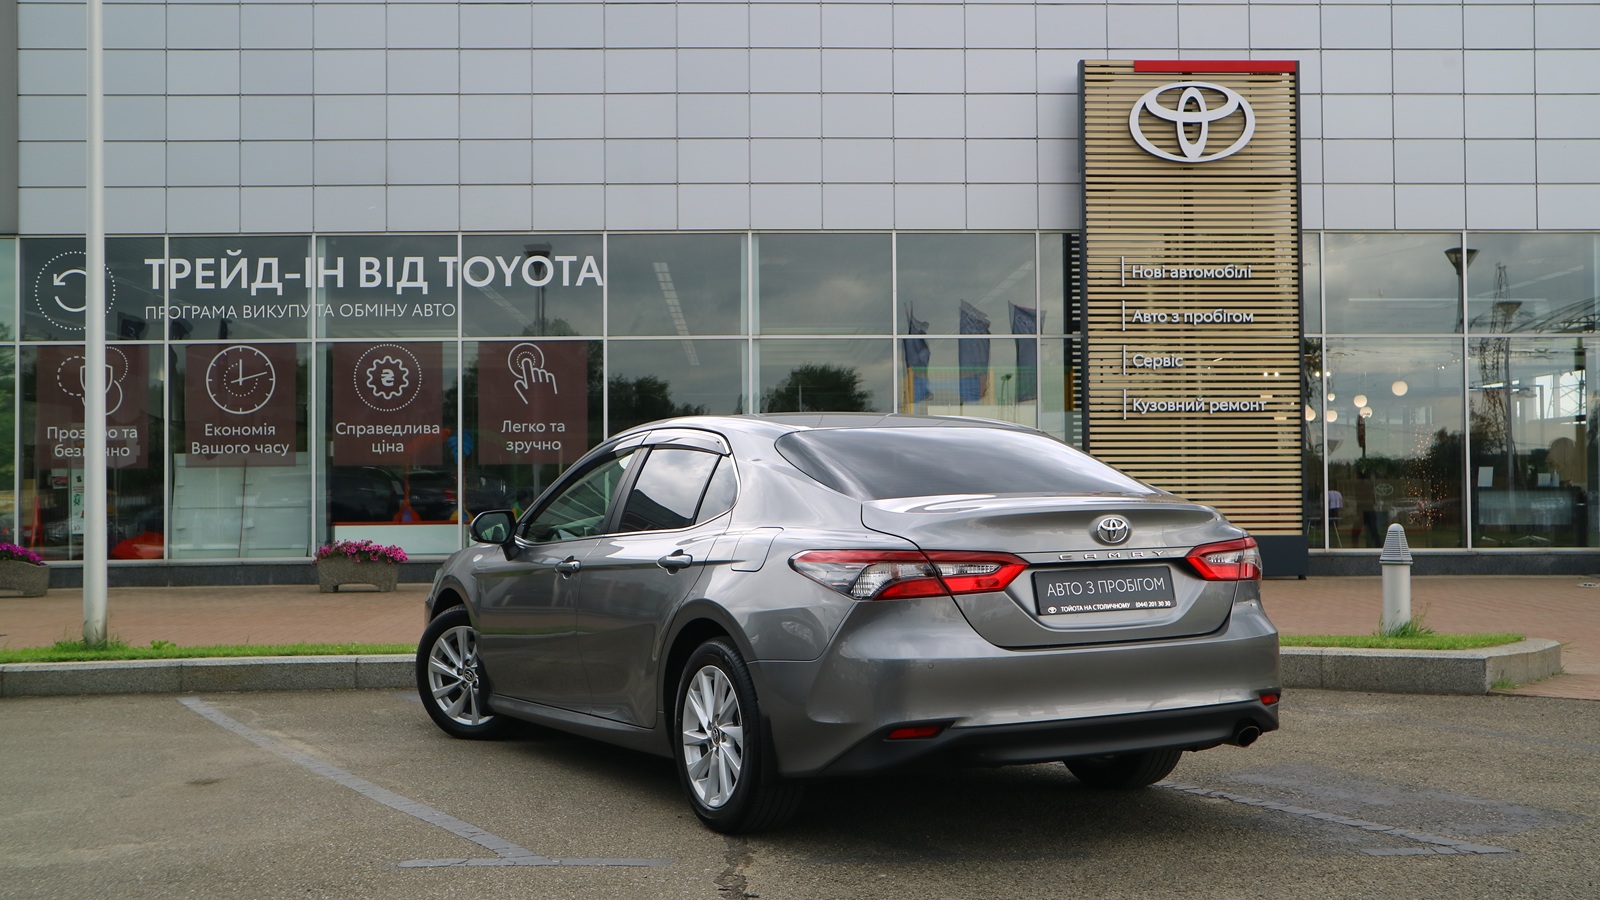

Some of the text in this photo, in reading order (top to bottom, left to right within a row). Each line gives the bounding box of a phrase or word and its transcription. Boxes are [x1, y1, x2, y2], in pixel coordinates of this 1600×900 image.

[144, 249, 604, 296] ТРЕЙД-ІН ВІД TOYOTA
[1132, 265, 1252, 279] Нові автомобілі
[145, 303, 456, 320] ПРОГРАМА ВИКУПУ ТА ОБМІНУ АВТО
[1131, 309, 1255, 326] Авто з пробігом
[1132, 353, 1184, 370] Сервіс
[1132, 397, 1267, 415] Кузовний ремонт
[47, 426, 138, 442] Прозо та
[204, 423, 276, 436] Економія
[335, 421, 440, 436] Справедлива
[501, 420, 566, 434] Легко та
[191, 442, 290, 456] Вашого часу
[371, 440, 404, 454] ціна
[505, 440, 562, 454] зручно
[1059, 550, 1164, 560] CAMRY
[1047, 581, 1083, 597] АВТО
[1098, 577, 1165, 594] ПРОБІГОМ
[1060, 604, 1083, 612] ТОЙОТА
